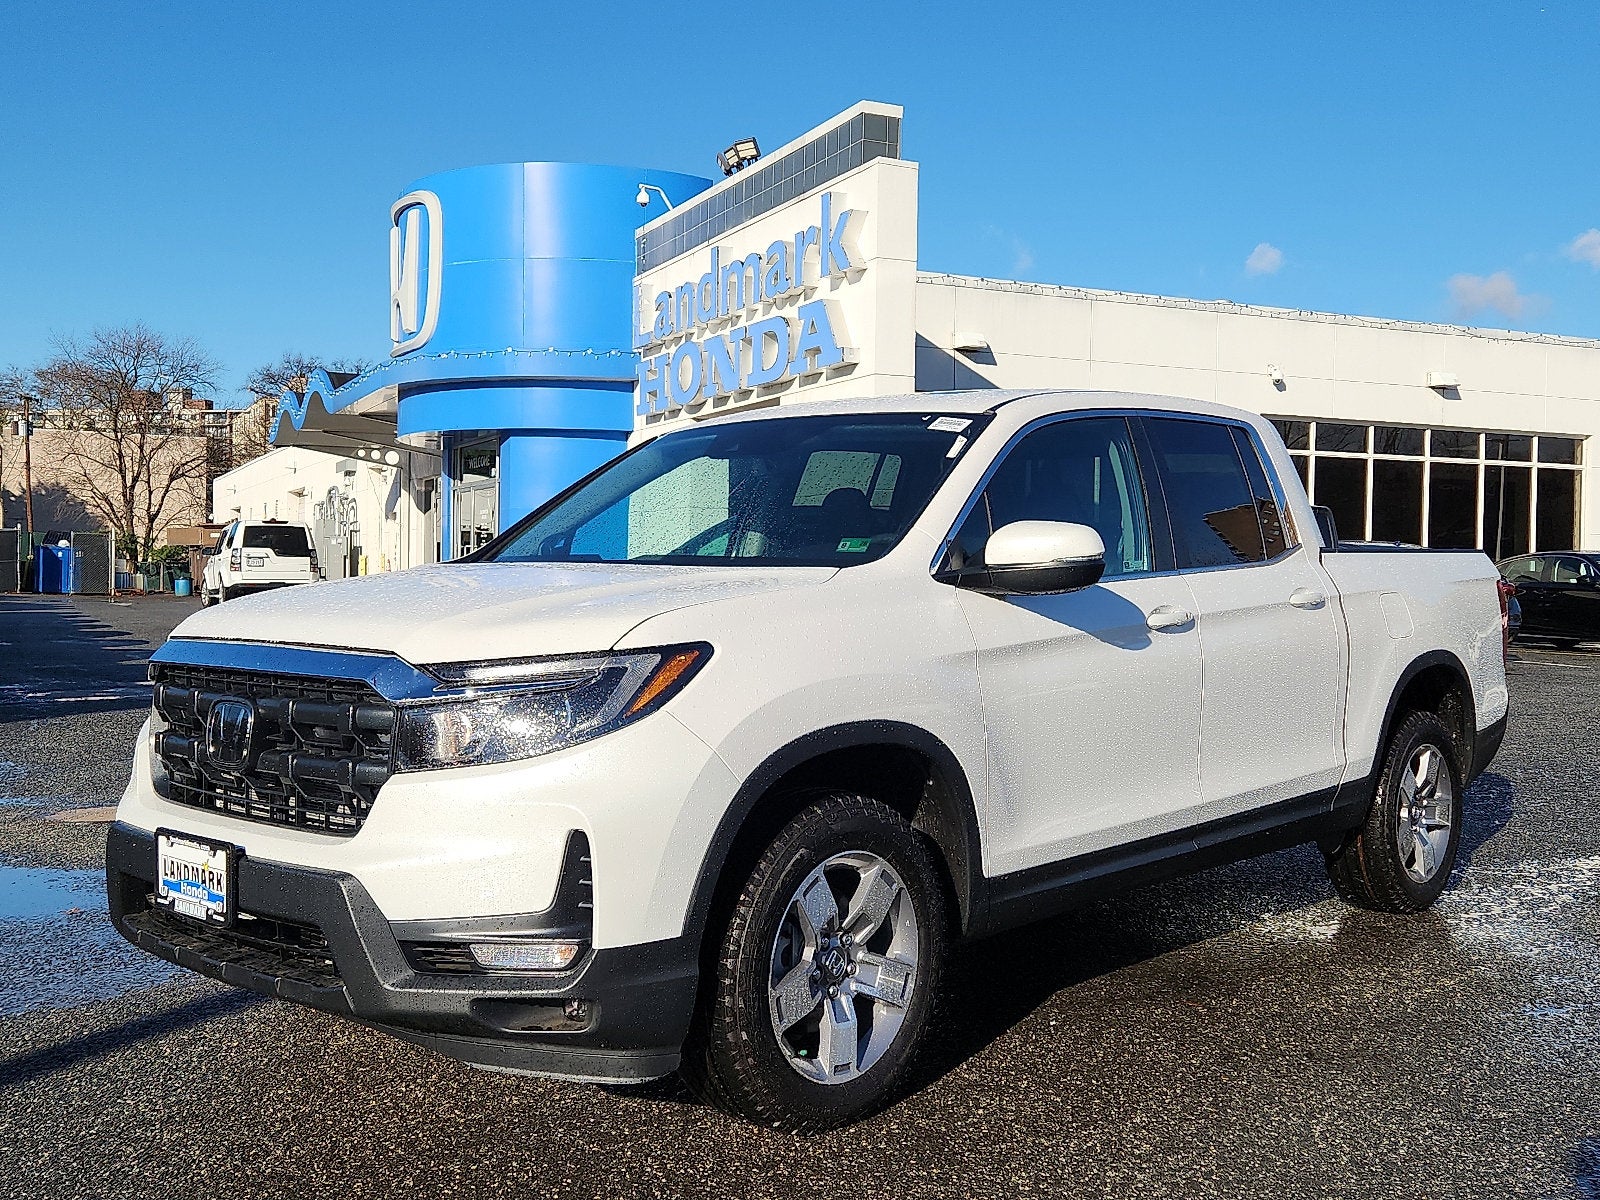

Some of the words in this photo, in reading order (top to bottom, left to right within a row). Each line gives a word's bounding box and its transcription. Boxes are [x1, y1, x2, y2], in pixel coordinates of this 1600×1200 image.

[633, 192, 855, 349] Landmark
[636, 299, 847, 416] HONDA
[468, 455, 490, 469] WELCOME
[163, 858, 223, 893] LANDMARK
[181, 882, 209, 900] Honda
